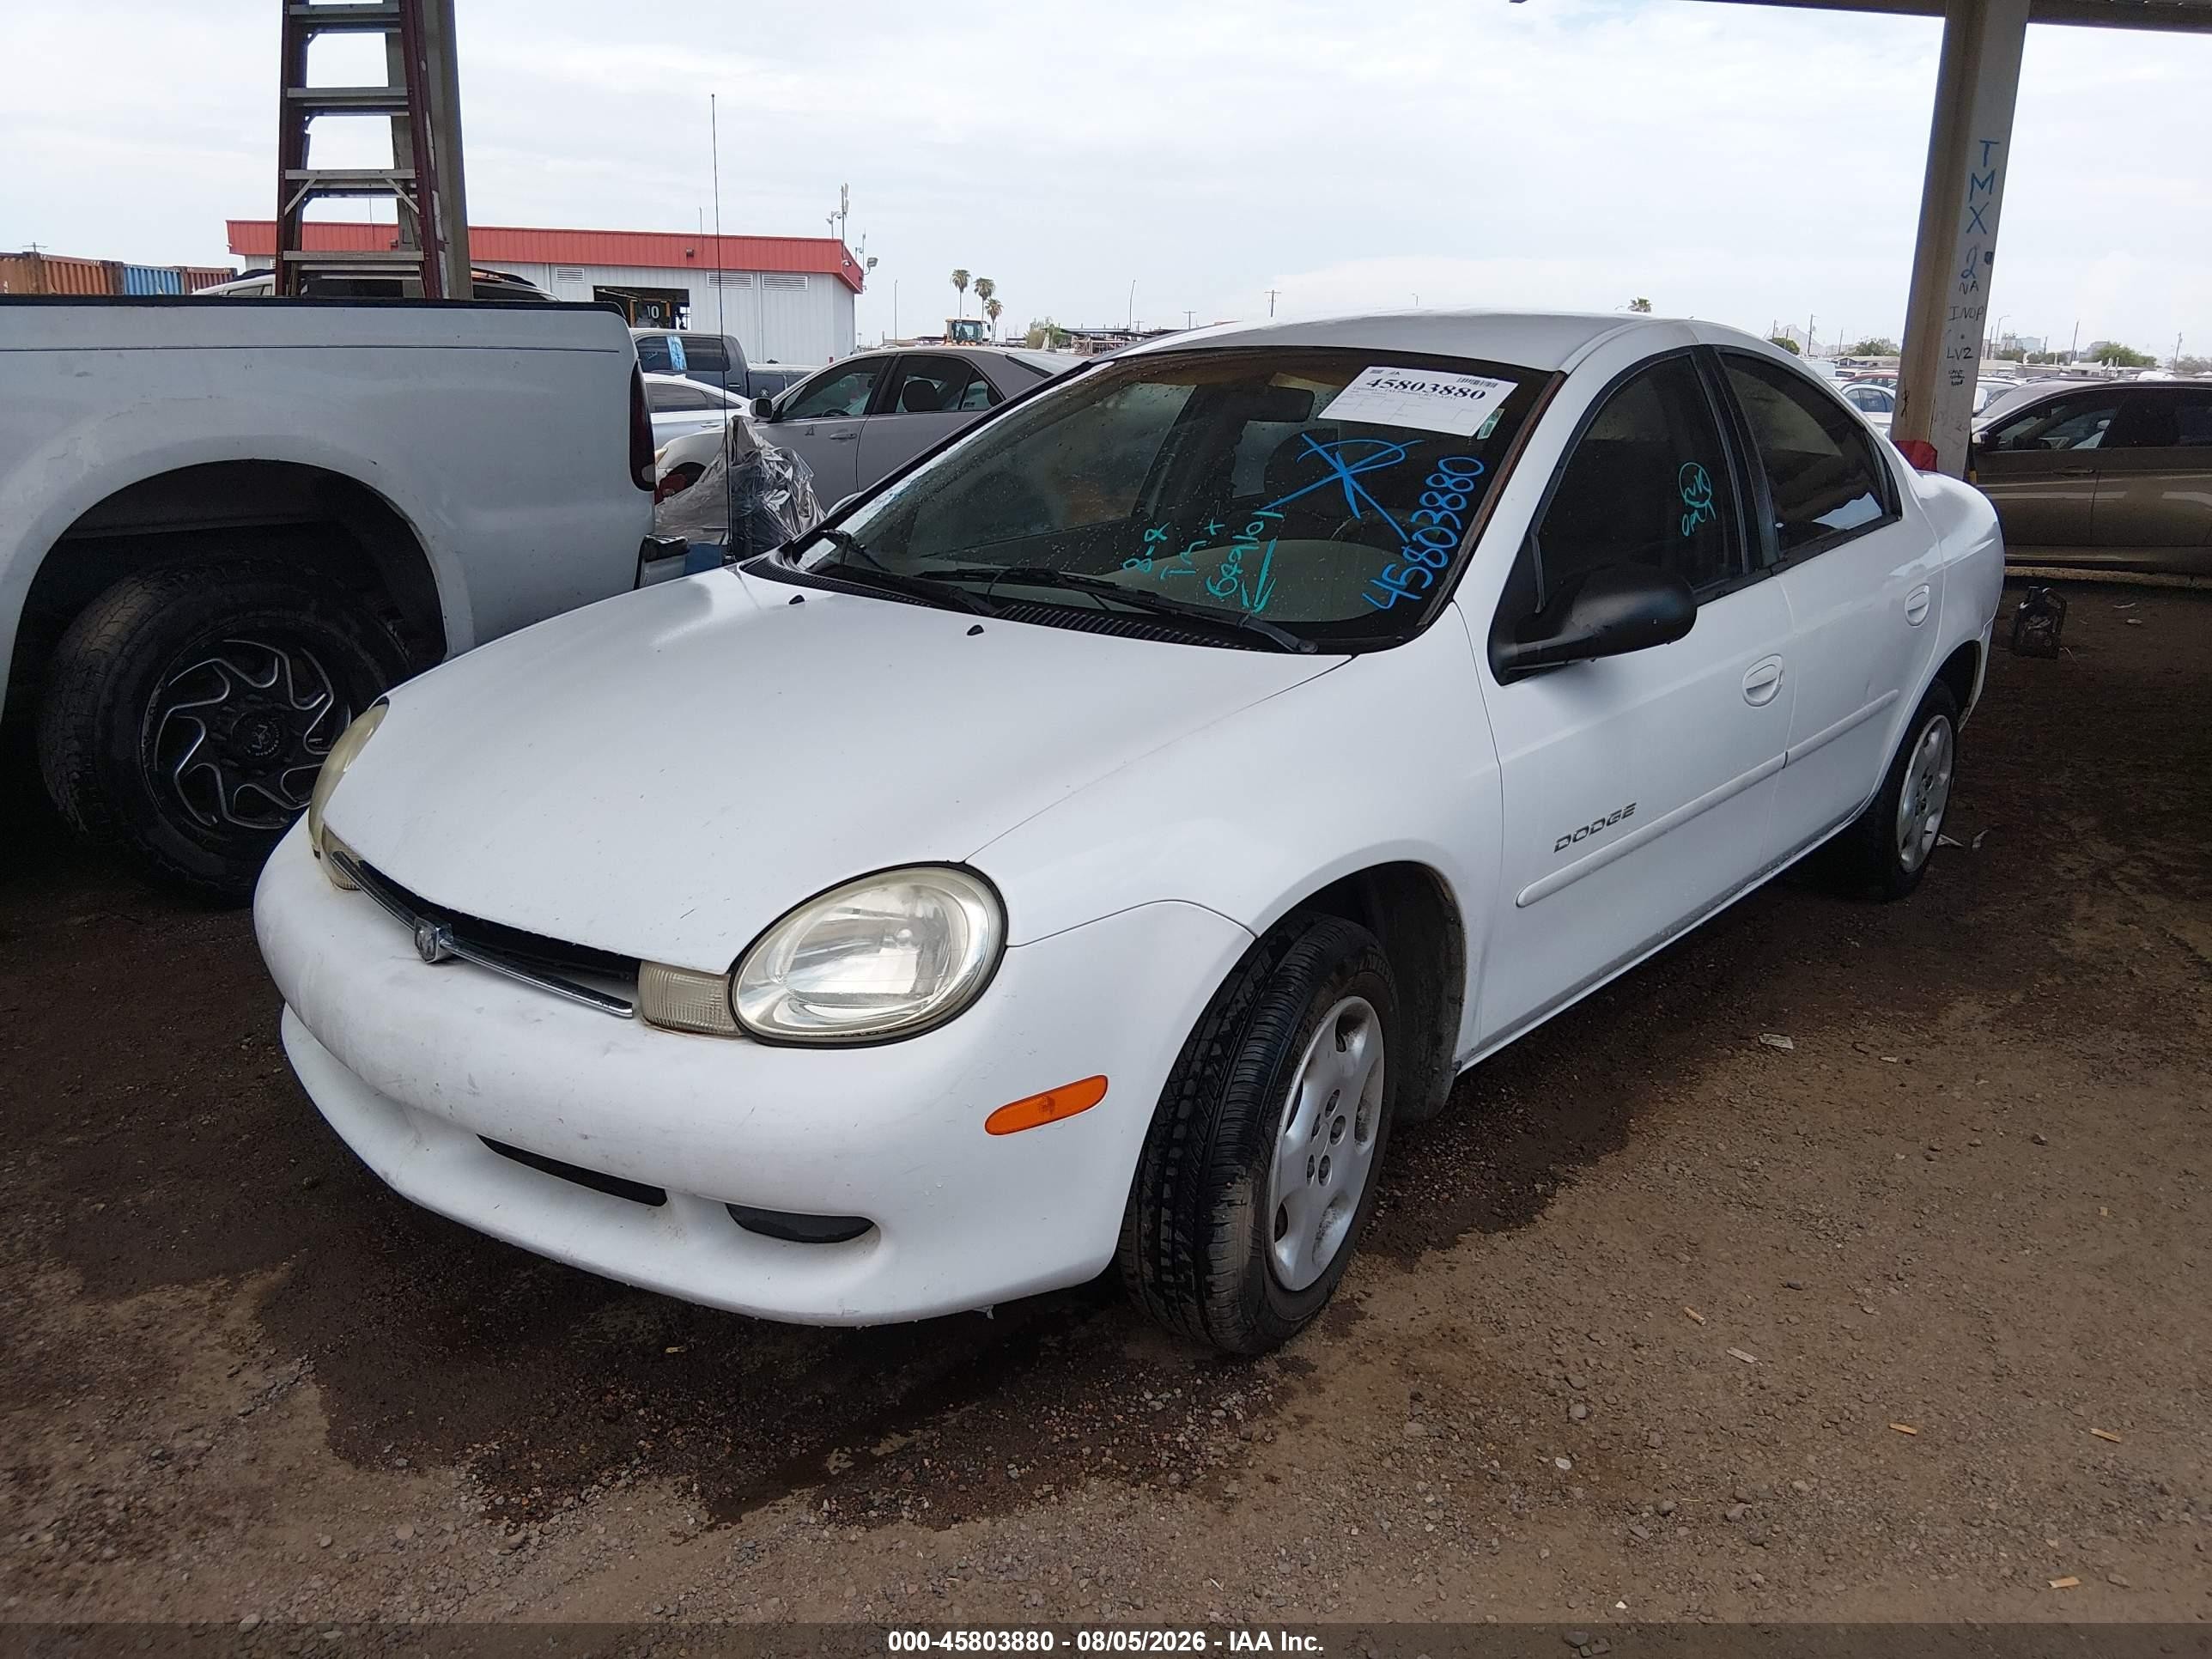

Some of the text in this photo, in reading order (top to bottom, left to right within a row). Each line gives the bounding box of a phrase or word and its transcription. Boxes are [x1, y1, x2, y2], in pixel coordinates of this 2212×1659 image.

[1964, 139, 2000, 234] TMX
[647, 305, 659, 319] 10
[1948, 305, 1985, 322] INOP
[1946, 346, 1974, 361] LV2
[1365, 378, 1486, 400] 45803880
[1362, 456, 1485, 610] 45803880
[1553, 802, 1637, 853] DODGE
